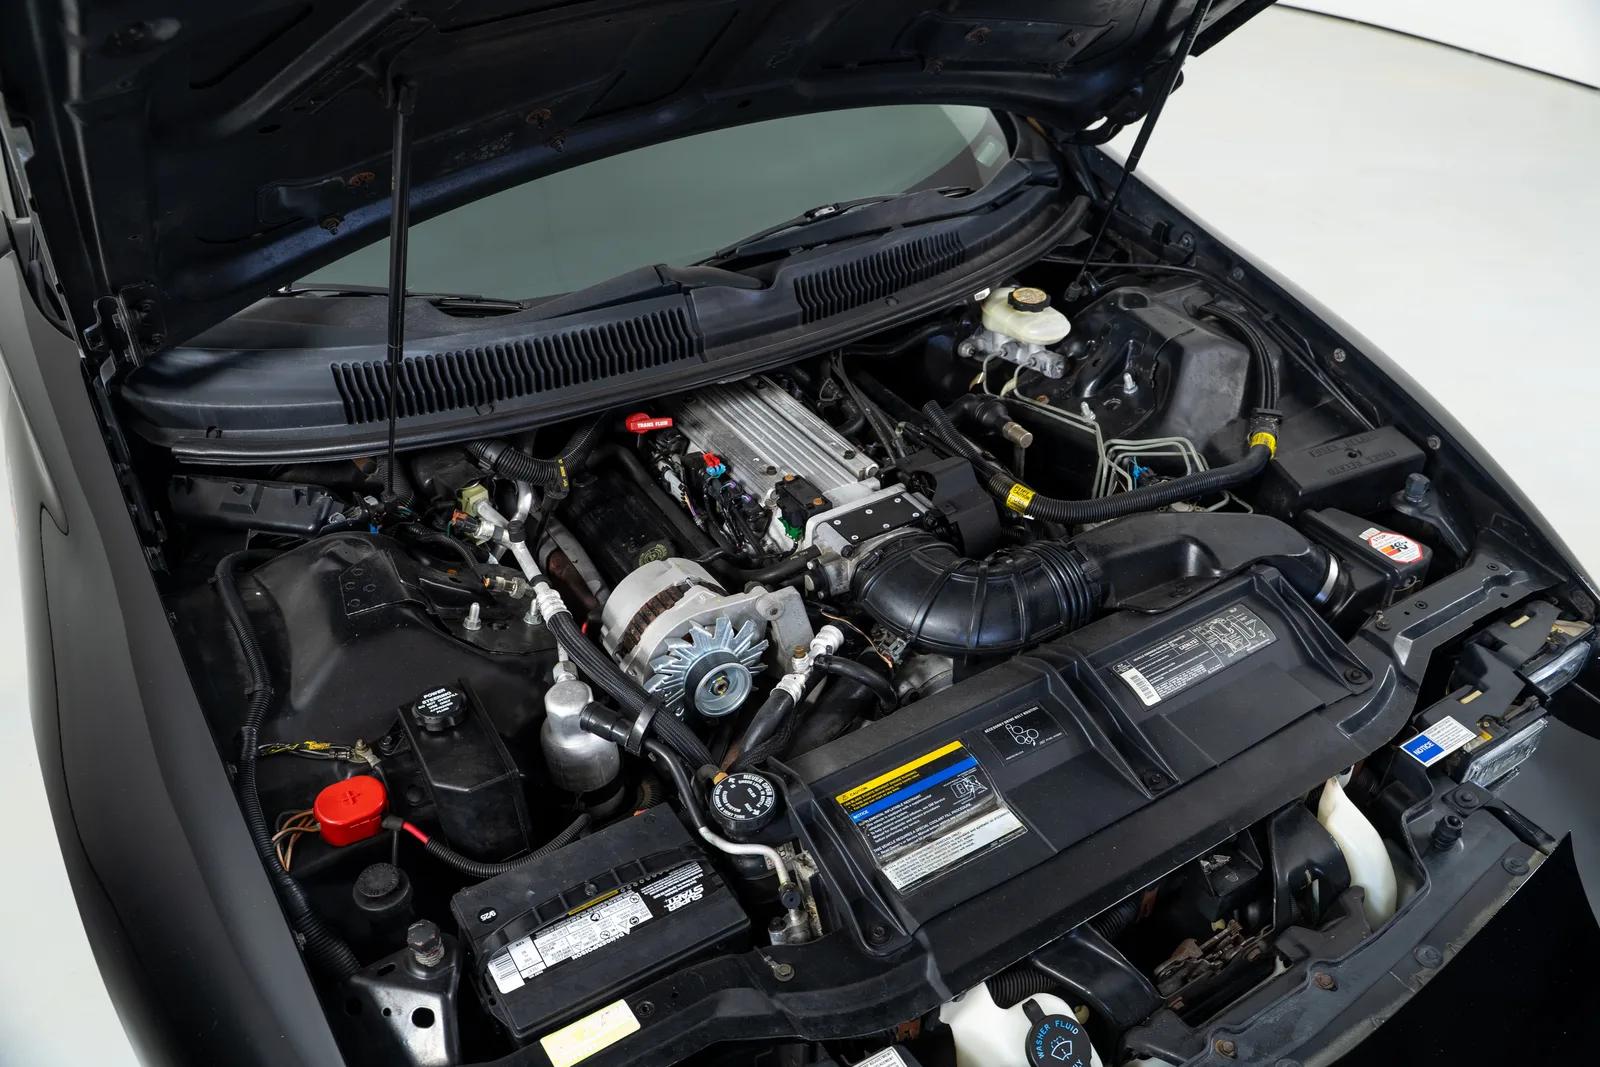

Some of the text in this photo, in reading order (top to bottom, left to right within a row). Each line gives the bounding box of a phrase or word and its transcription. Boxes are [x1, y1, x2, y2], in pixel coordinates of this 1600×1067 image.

[421, 691, 452, 704] STEERING
[423, 688, 446, 699] POWER
[1412, 740, 1435, 755] NOTICE
[743, 775, 763, 783] NEVER
[762, 782, 772, 795] OPEN
[848, 785, 868, 796] CAUTION
[764, 797, 772, 807] HOT
[852, 809, 869, 819] NOTICE
[666, 891, 703, 912] SUPER
[479, 909, 495, 921] 9/25
[1036, 1020, 1079, 1059] WASHER FLUID
